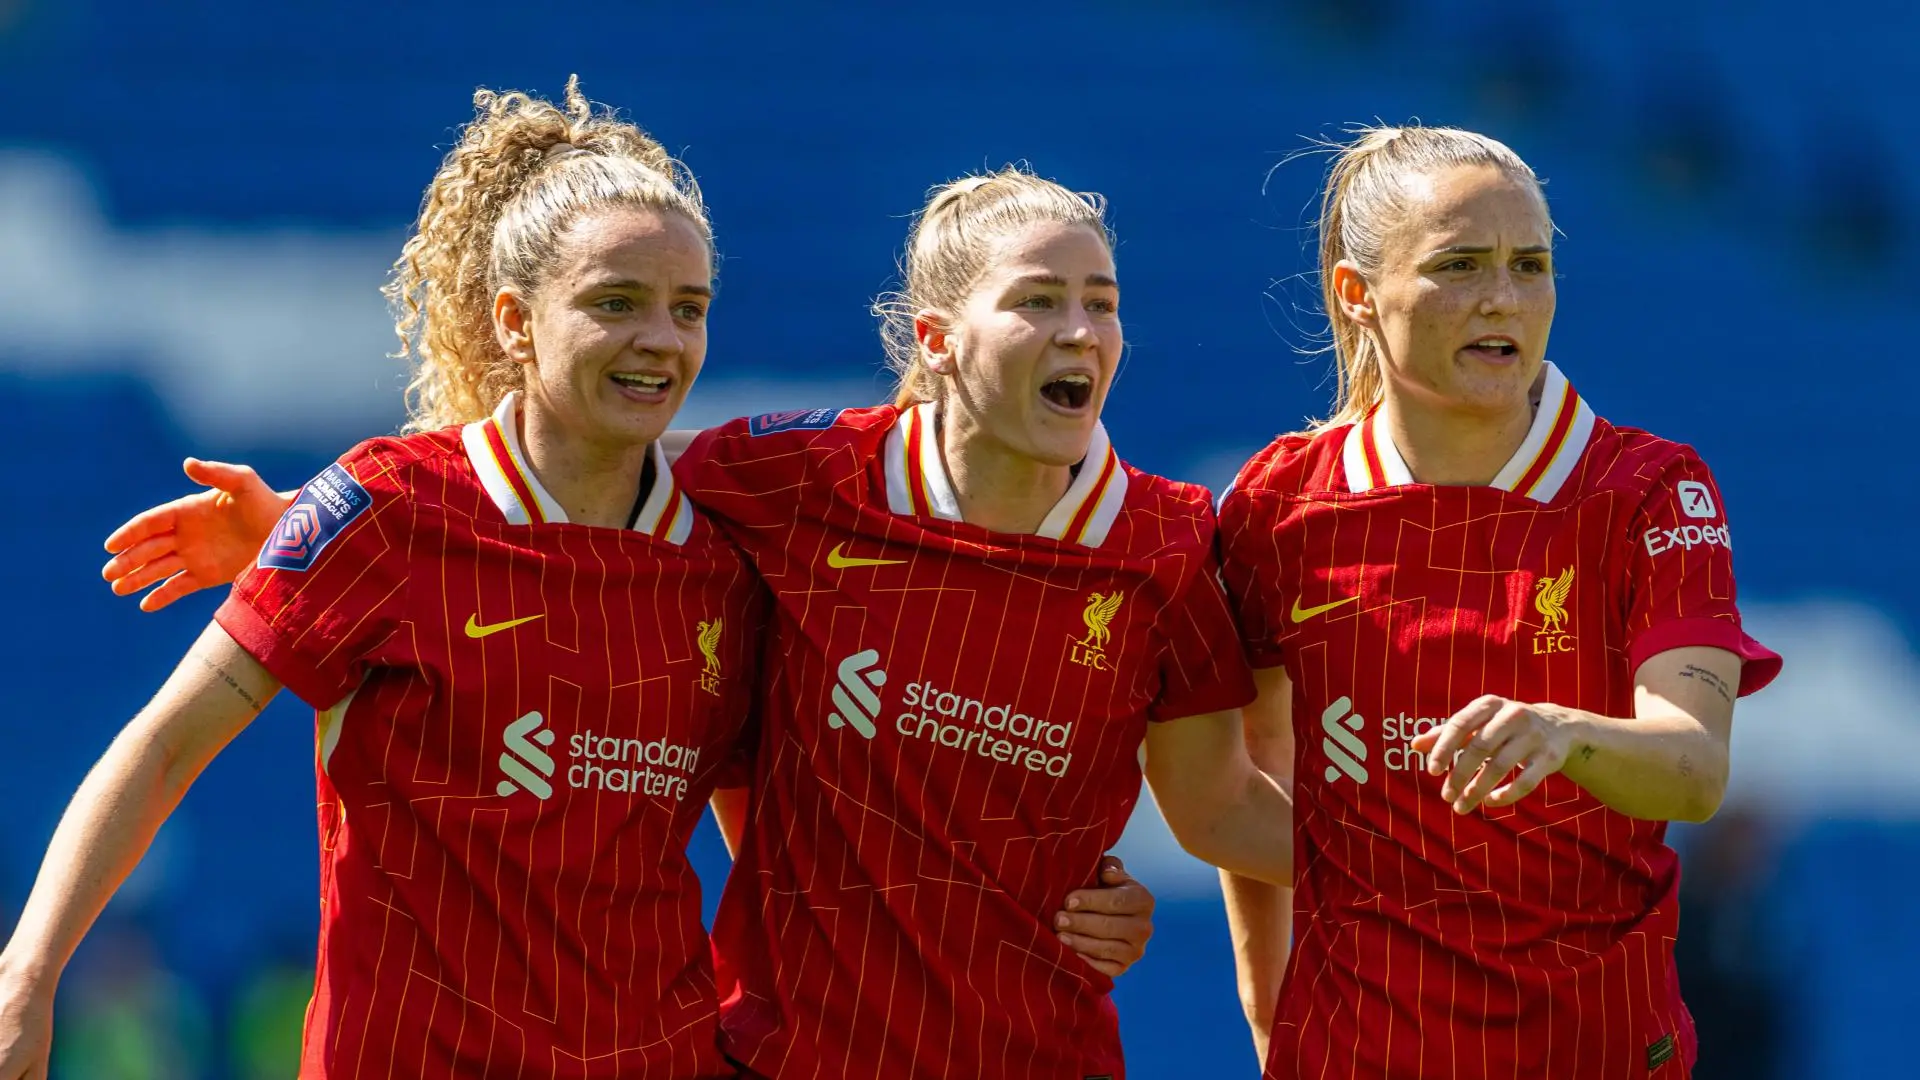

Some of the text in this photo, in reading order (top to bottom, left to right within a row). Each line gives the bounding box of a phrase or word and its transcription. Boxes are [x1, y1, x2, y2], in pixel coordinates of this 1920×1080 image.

[326, 472, 361, 506] BARCLAYS
[1643, 522, 1732, 556] Expedi
[902, 681, 1072, 748] standard
[568, 729, 700, 774] standard
[896, 711, 1072, 778] chartered
[567, 761, 688, 801] chartere
